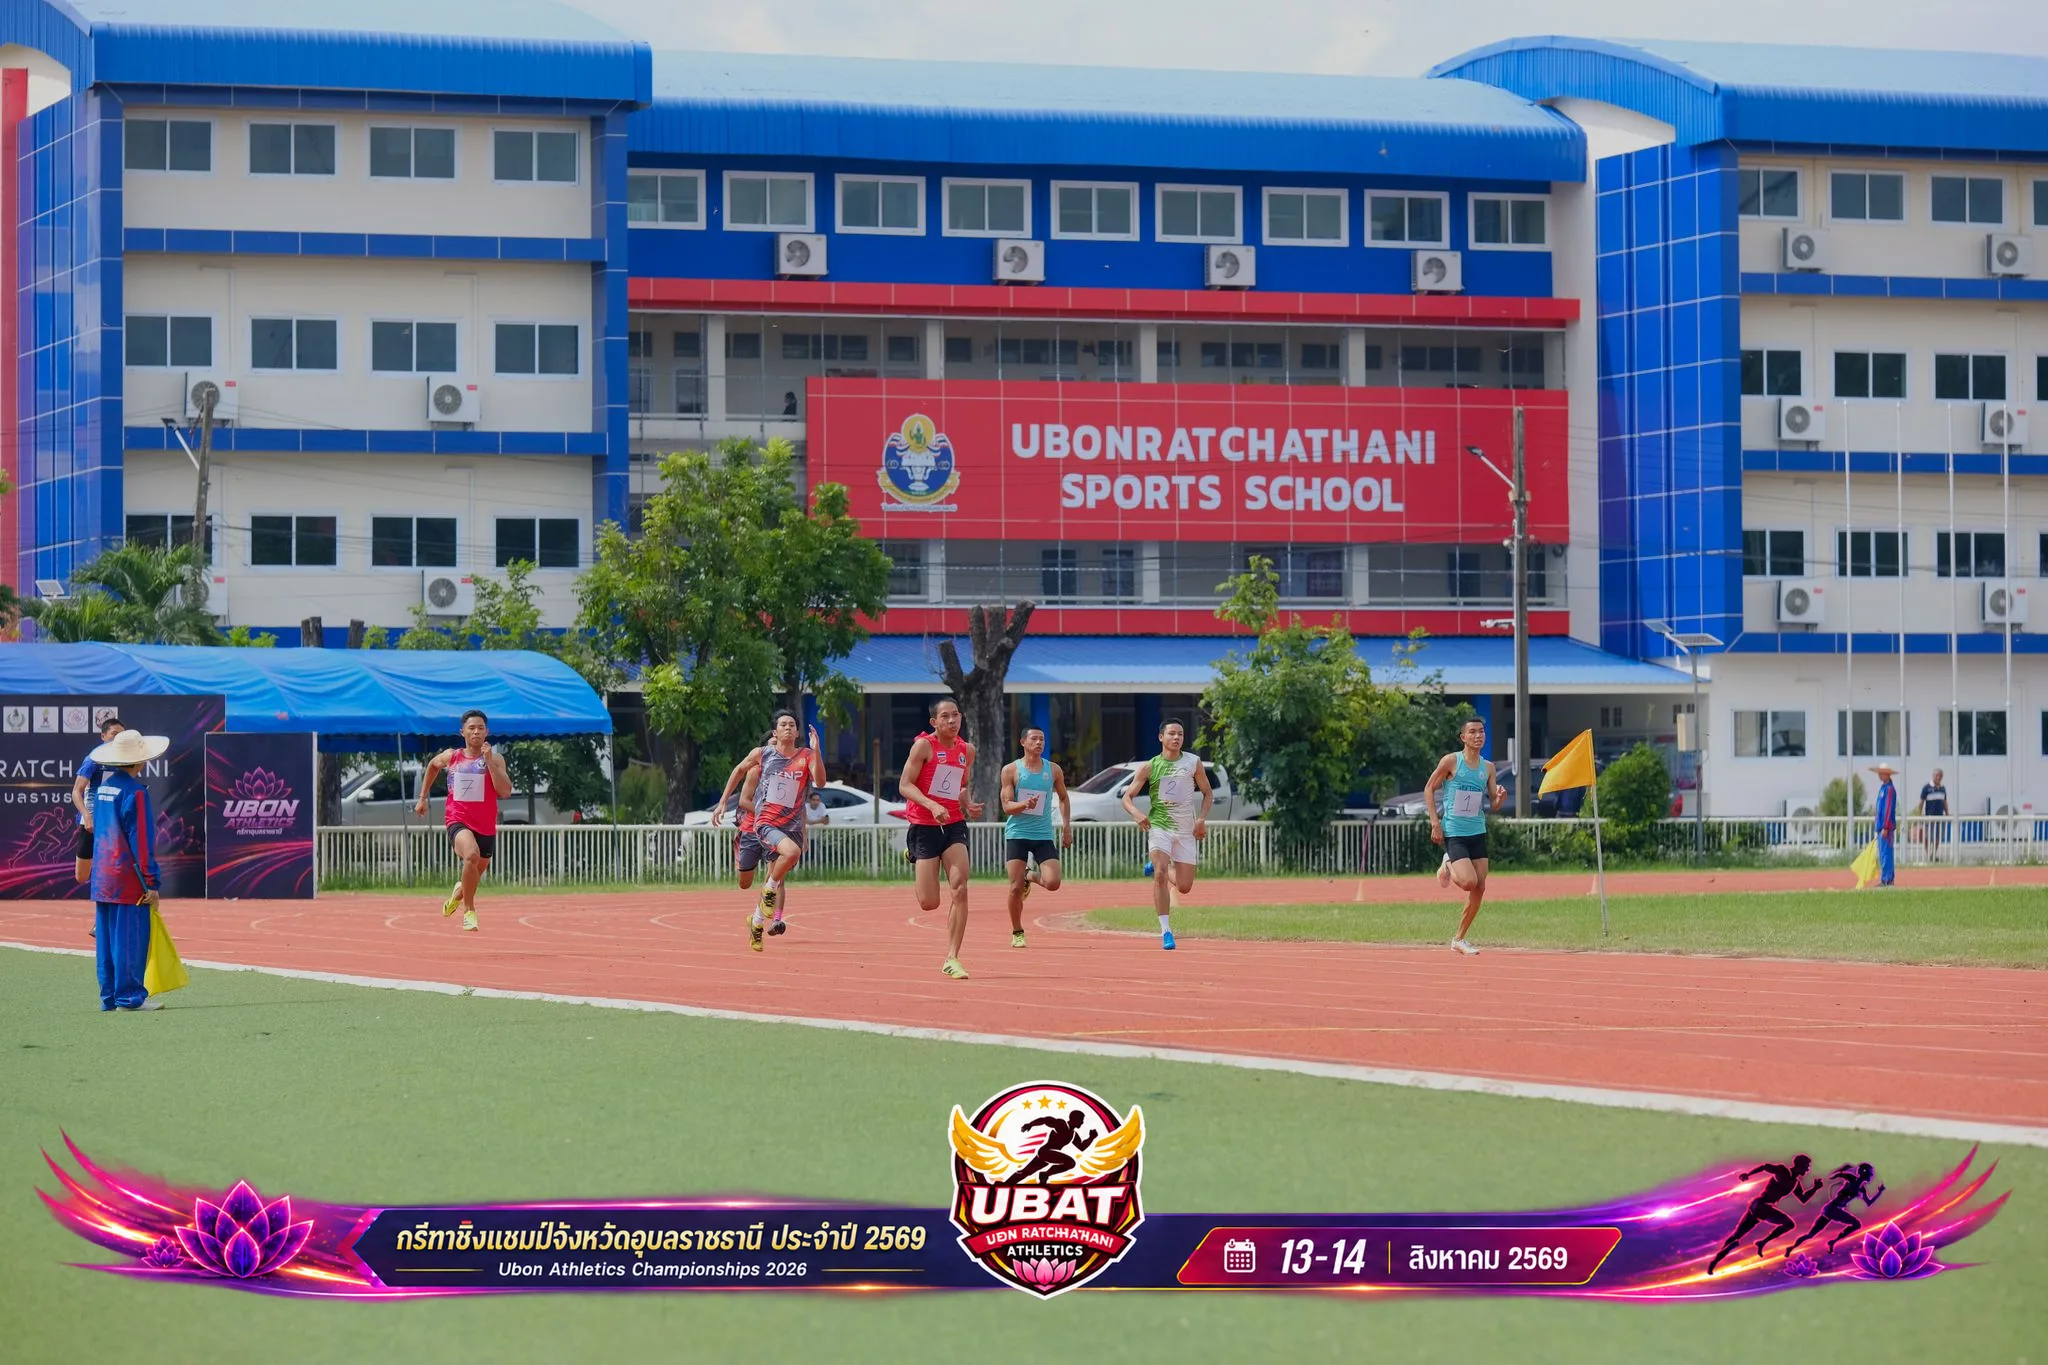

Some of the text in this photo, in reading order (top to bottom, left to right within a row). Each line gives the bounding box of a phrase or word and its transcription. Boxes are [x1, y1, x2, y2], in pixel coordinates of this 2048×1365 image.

[1012, 423, 1435, 464] UBONRATCHATHANI
[1061, 473, 1404, 512] SPORTS SCHOOL
[460, 779, 474, 797] 7
[941, 770, 952, 790] 6
[1164, 780, 1177, 796] 2
[776, 782, 787, 801] 5
[222, 799, 300, 818] UBON
[1460, 793, 1471, 812] 1
[223, 817, 296, 828] ATHLETICS
